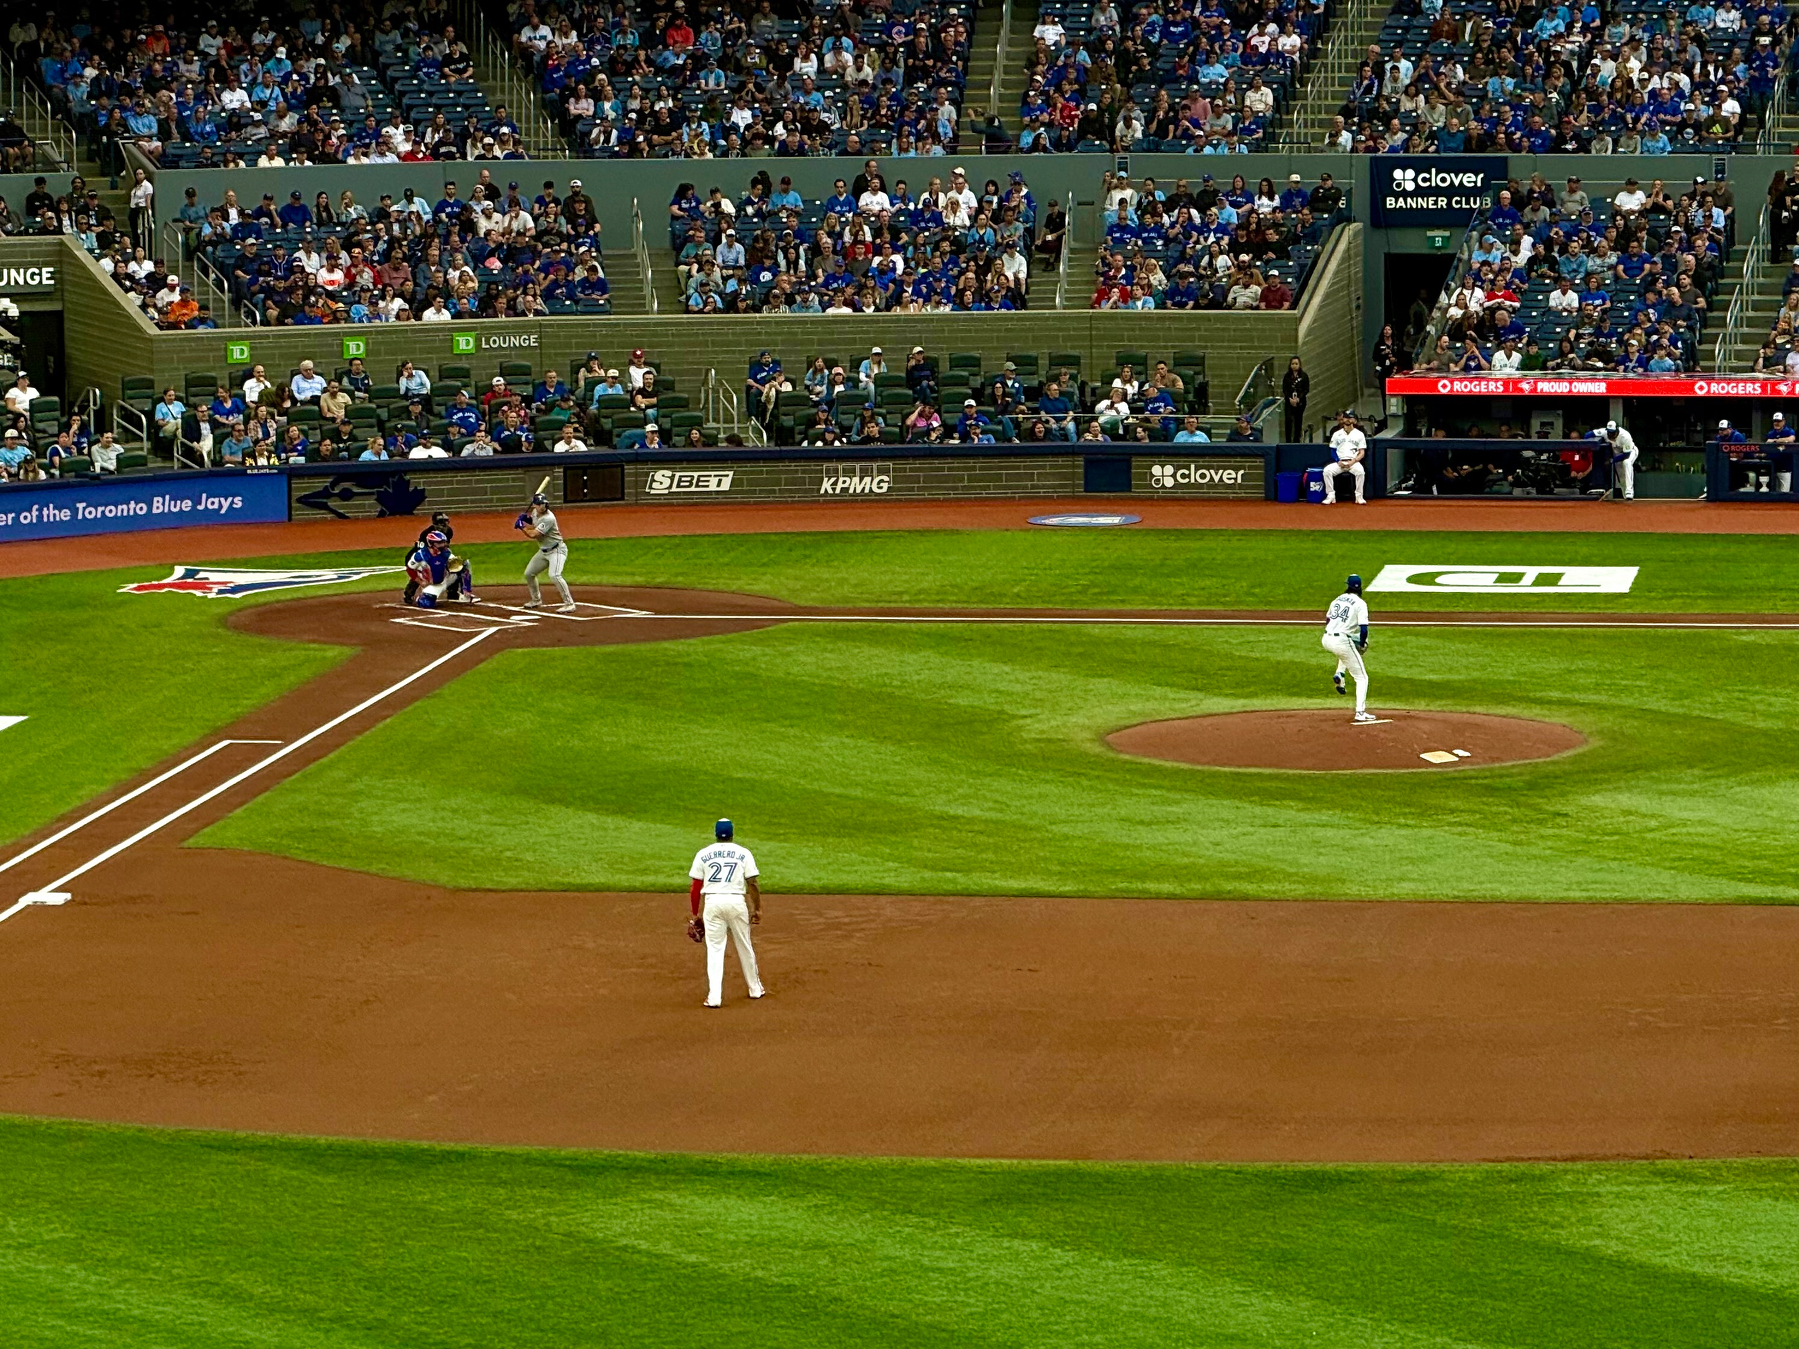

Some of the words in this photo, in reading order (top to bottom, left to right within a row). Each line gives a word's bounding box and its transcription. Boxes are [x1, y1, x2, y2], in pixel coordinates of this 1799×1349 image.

[1417, 168, 1484, 187] clover
[1386, 197, 1447, 209] BANNER
[1452, 197, 1491, 209] CLUB
[347, 341, 365, 355] TD
[456, 336, 474, 350] TD
[481, 335, 538, 349] LOUNGE
[230, 345, 248, 360] TD
[1453, 381, 1504, 393] ROGERS
[1537, 381, 1569, 393] PROUD
[1571, 381, 1607, 393] OWNER
[1710, 383, 1762, 394] ROGERS
[1176, 464, 1245, 484] clover
[819, 475, 891, 494] KPMG
[20, 504, 39, 524] of
[43, 503, 71, 522] the
[76, 500, 148, 520] Toronto
[152, 495, 192, 514] Blue
[197, 493, 243, 515] Jays
[1330, 603, 1350, 623] 34
[708, 862, 738, 882] 27
